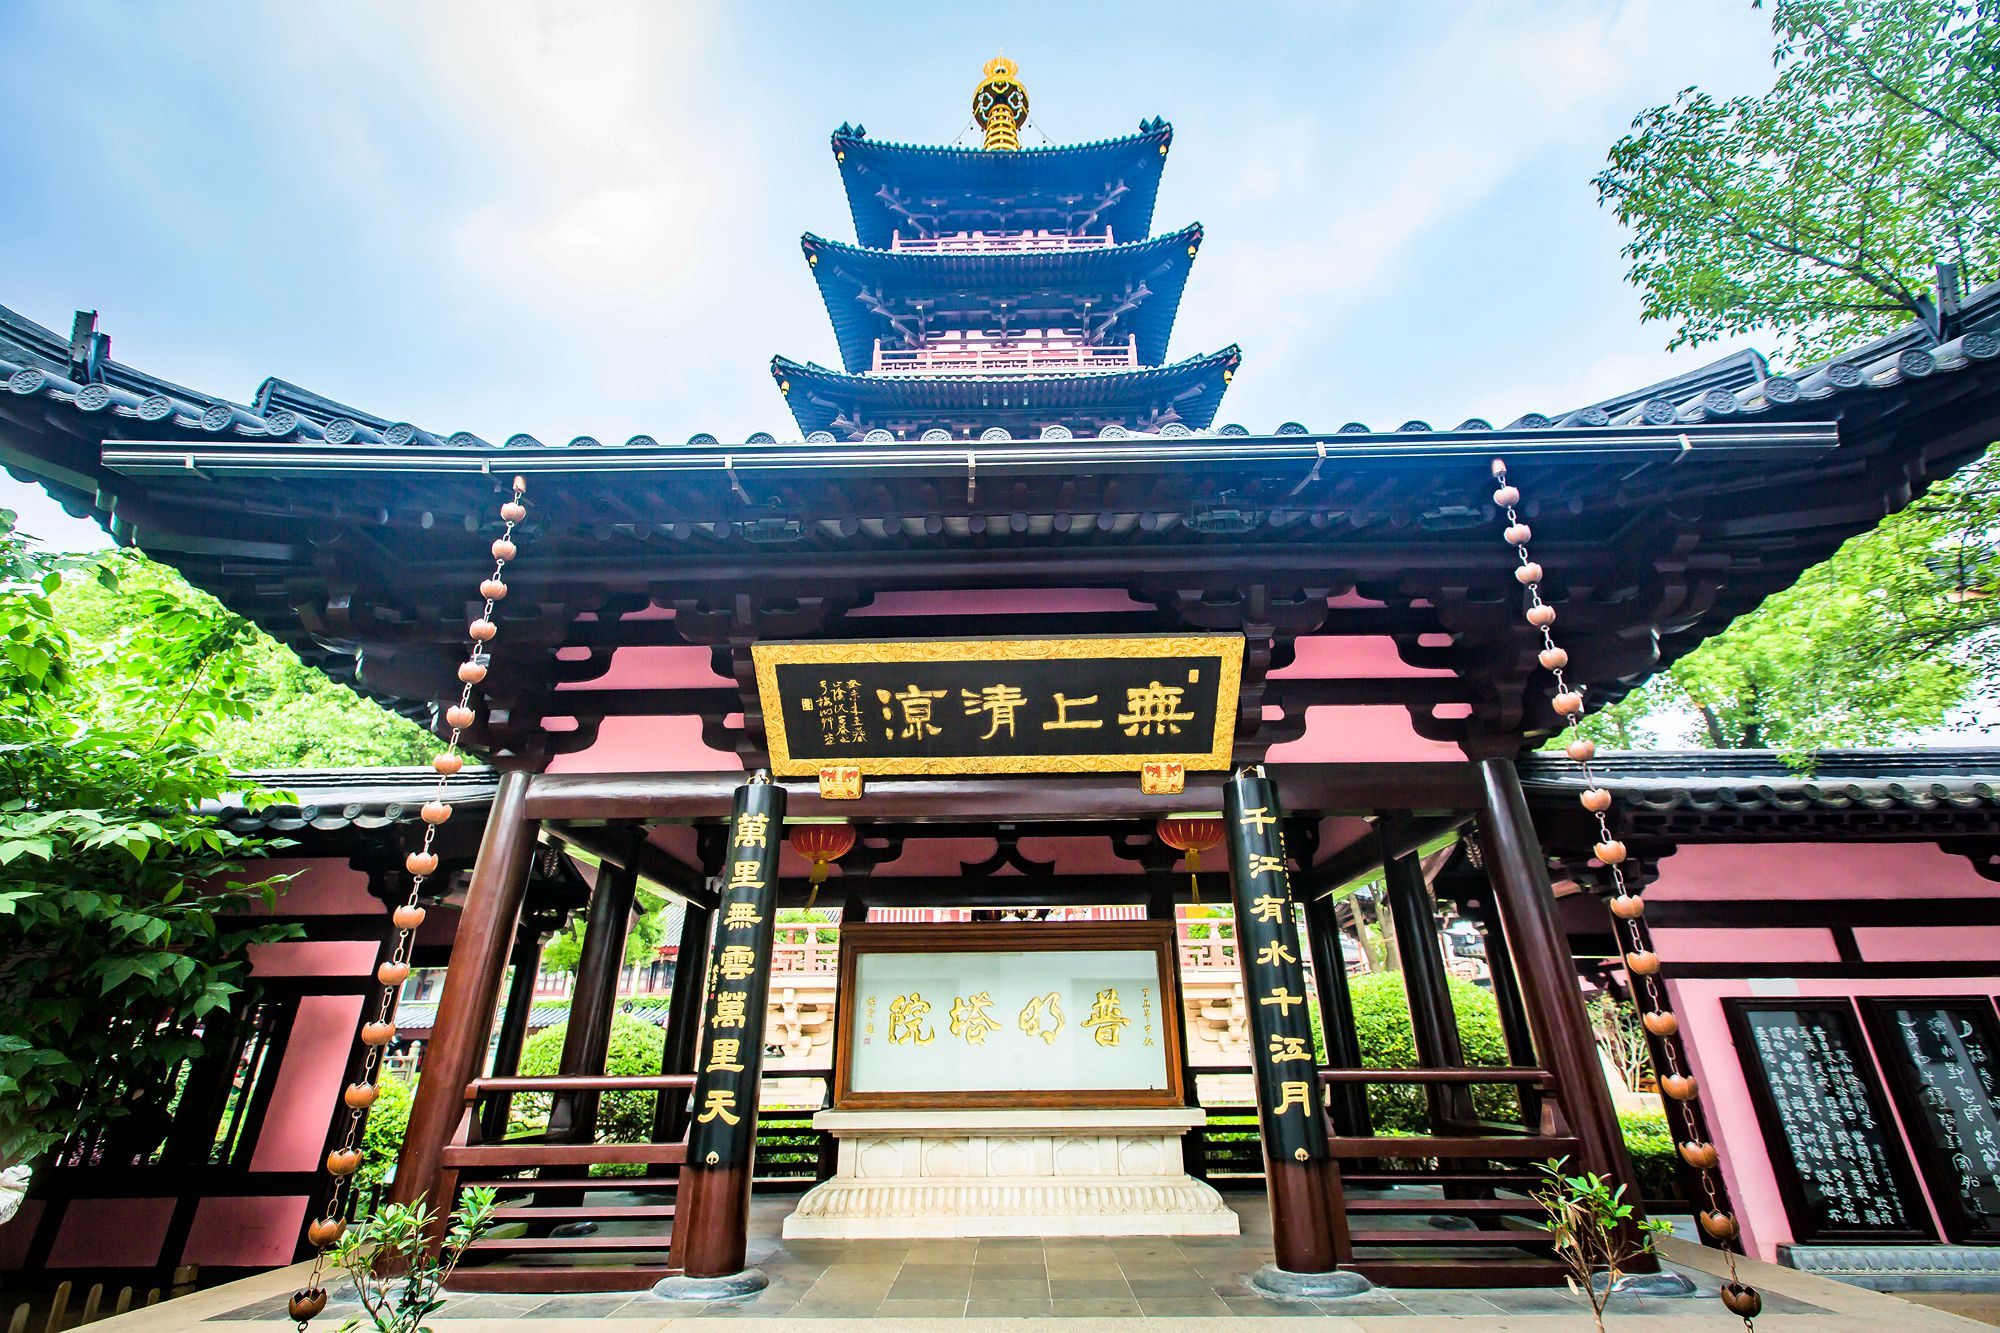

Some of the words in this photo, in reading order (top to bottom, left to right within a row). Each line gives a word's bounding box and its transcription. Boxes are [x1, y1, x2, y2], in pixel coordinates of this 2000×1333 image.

[697, 813, 770, 1126] 萬里無雲萬里天
[1239, 807, 1312, 1118] 千江有水千江月
